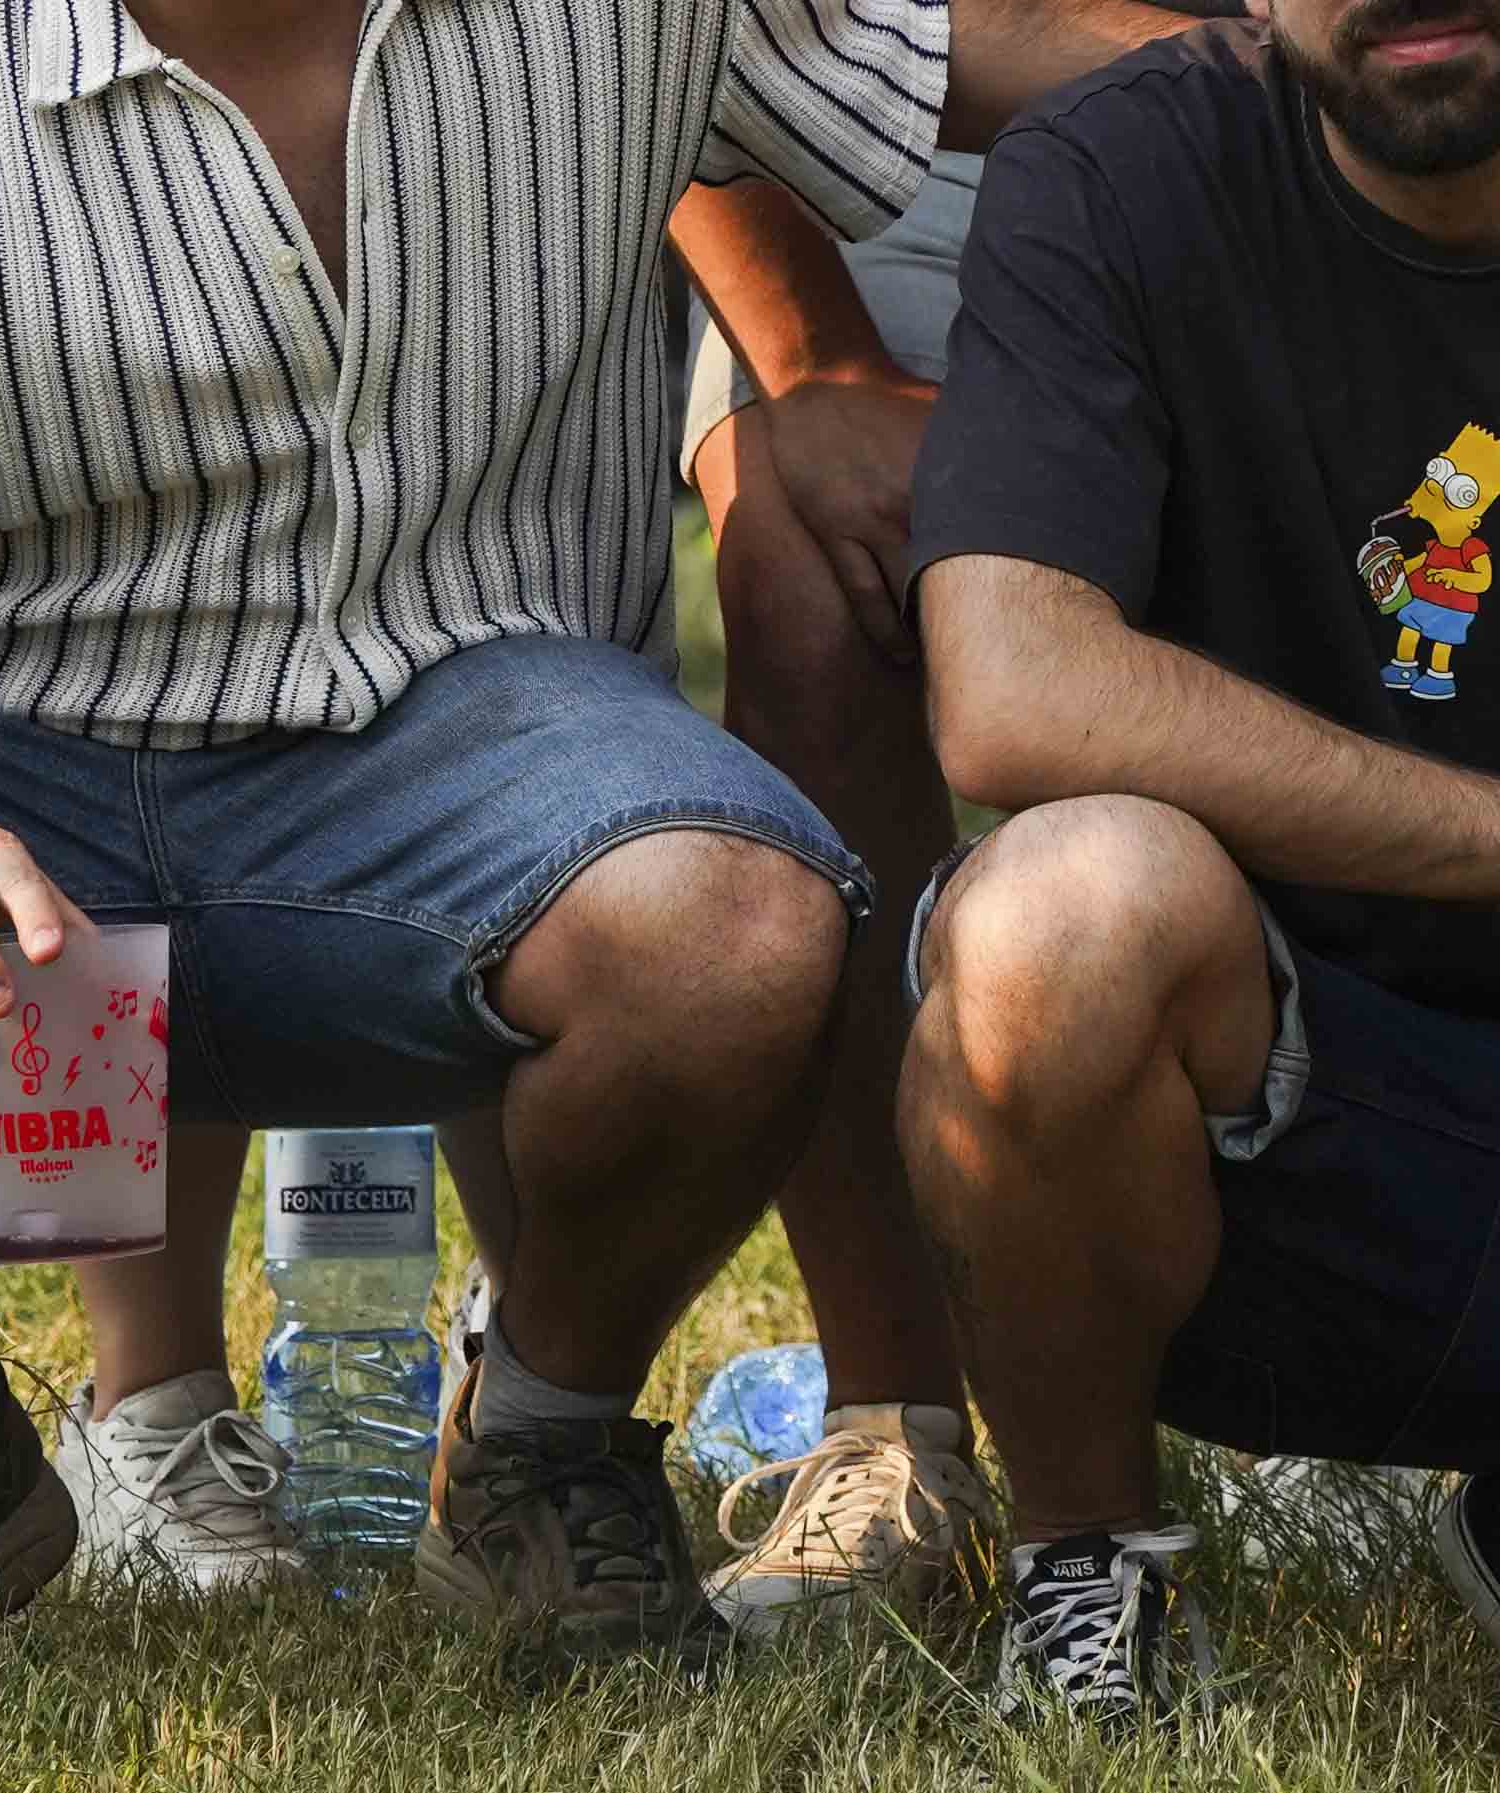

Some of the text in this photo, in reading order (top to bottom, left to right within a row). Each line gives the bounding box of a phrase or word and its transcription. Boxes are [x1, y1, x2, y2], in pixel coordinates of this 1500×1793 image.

[19, 1158, 75, 1175] Mahou
[283, 1189, 413, 1212] FONTECELTA
[1044, 1555, 1096, 1578] VANS
